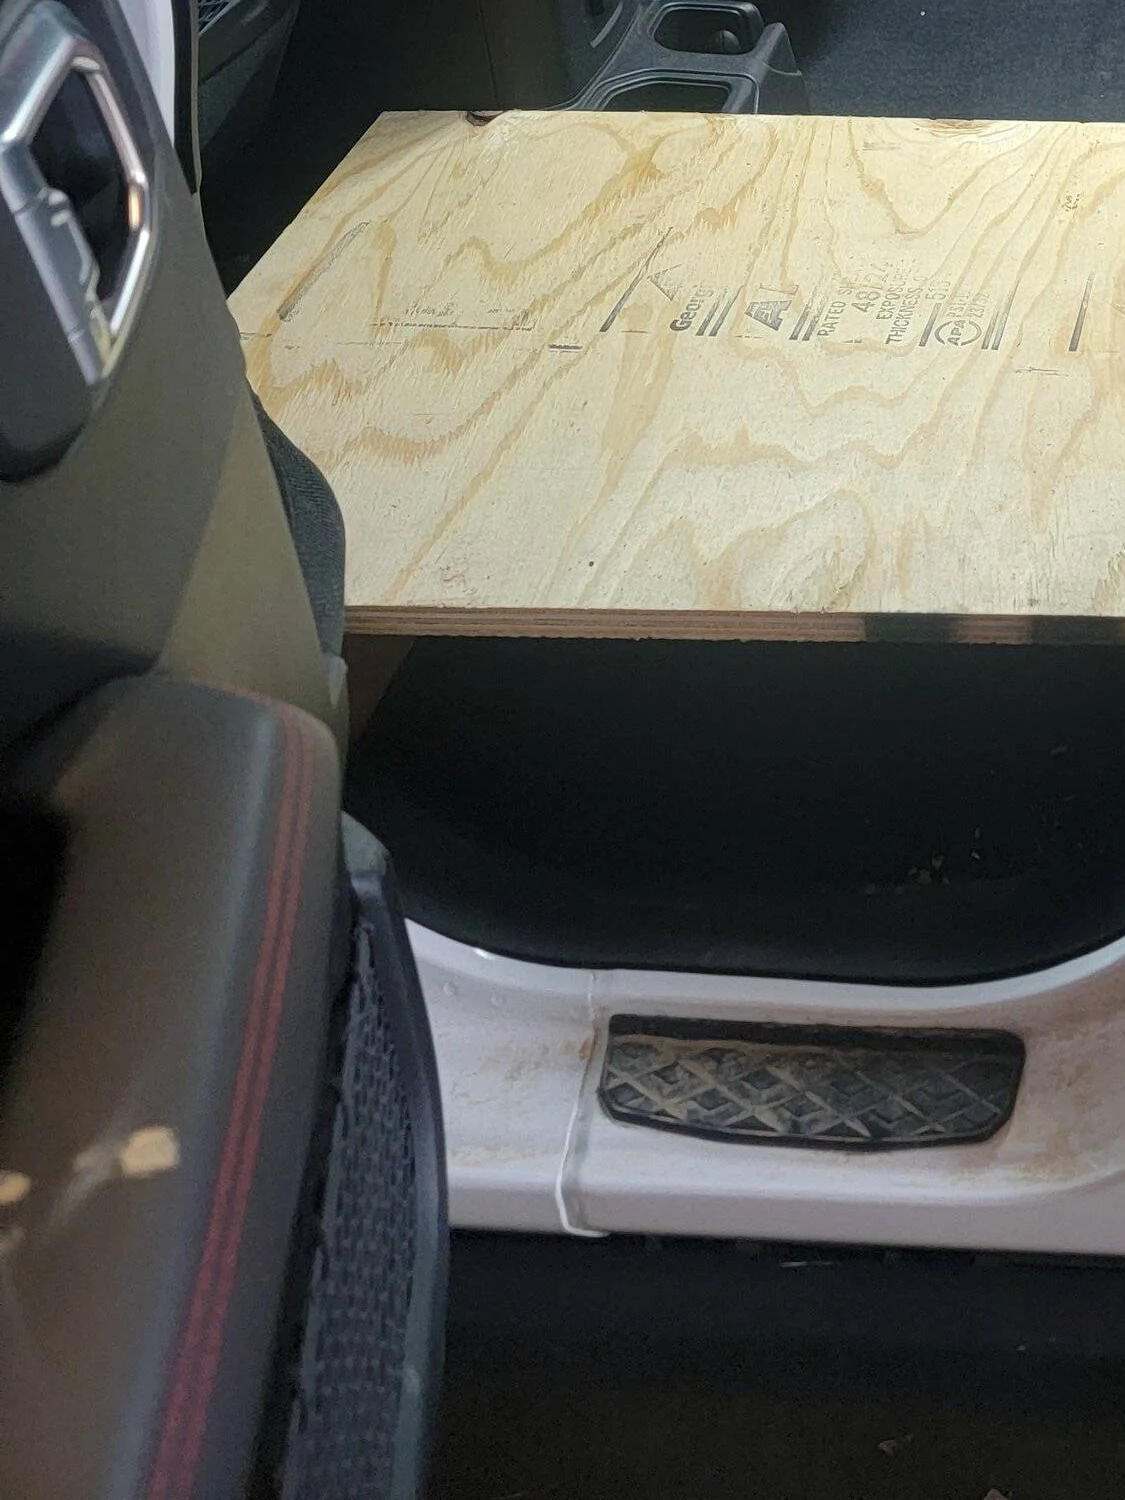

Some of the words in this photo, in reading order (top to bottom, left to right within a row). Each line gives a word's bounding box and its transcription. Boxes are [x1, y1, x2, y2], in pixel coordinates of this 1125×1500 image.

[817, 301, 847, 336] RATED
[885, 286, 922, 345] THICKNESS
[947, 319, 967, 347] APA
